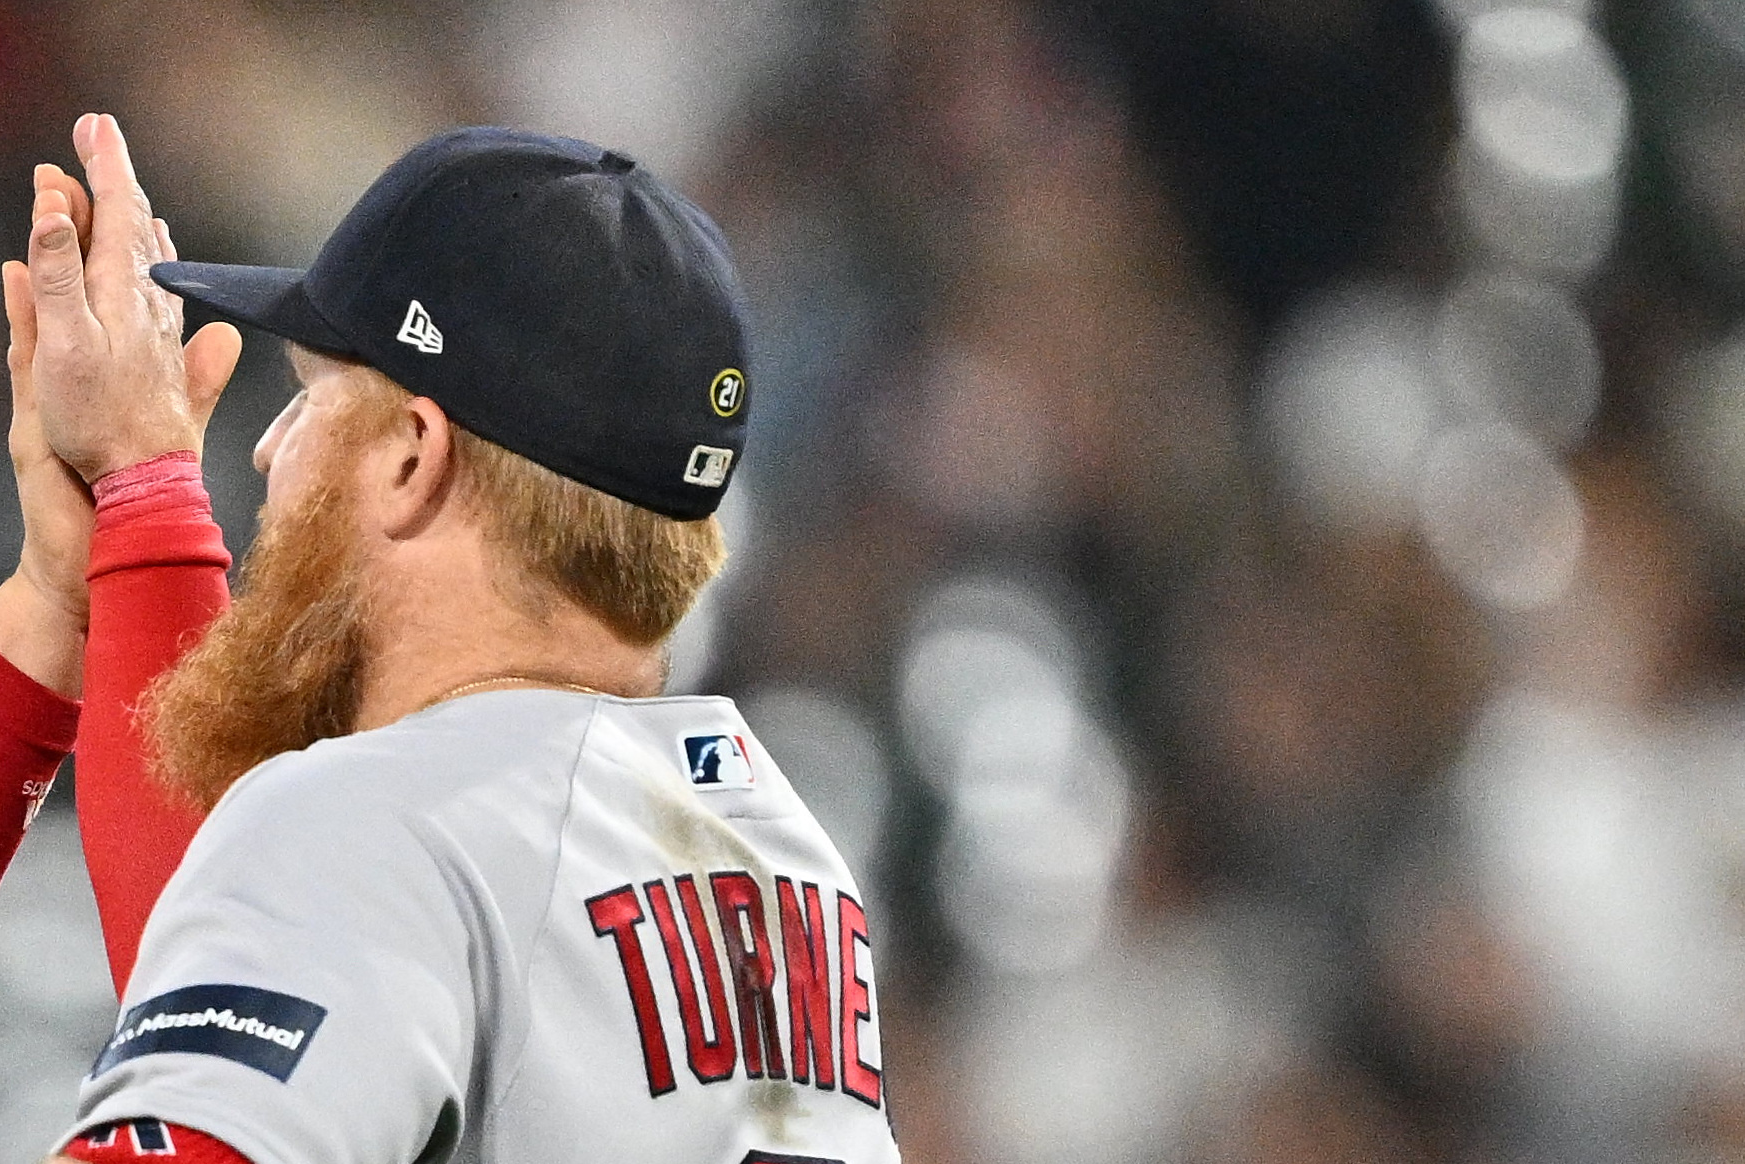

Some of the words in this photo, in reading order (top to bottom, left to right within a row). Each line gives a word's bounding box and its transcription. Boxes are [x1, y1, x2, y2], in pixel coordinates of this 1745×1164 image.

[718, 376, 740, 408] 21
[584, 870, 891, 1120] TURNE
[135, 1007, 305, 1051] MassMutual
